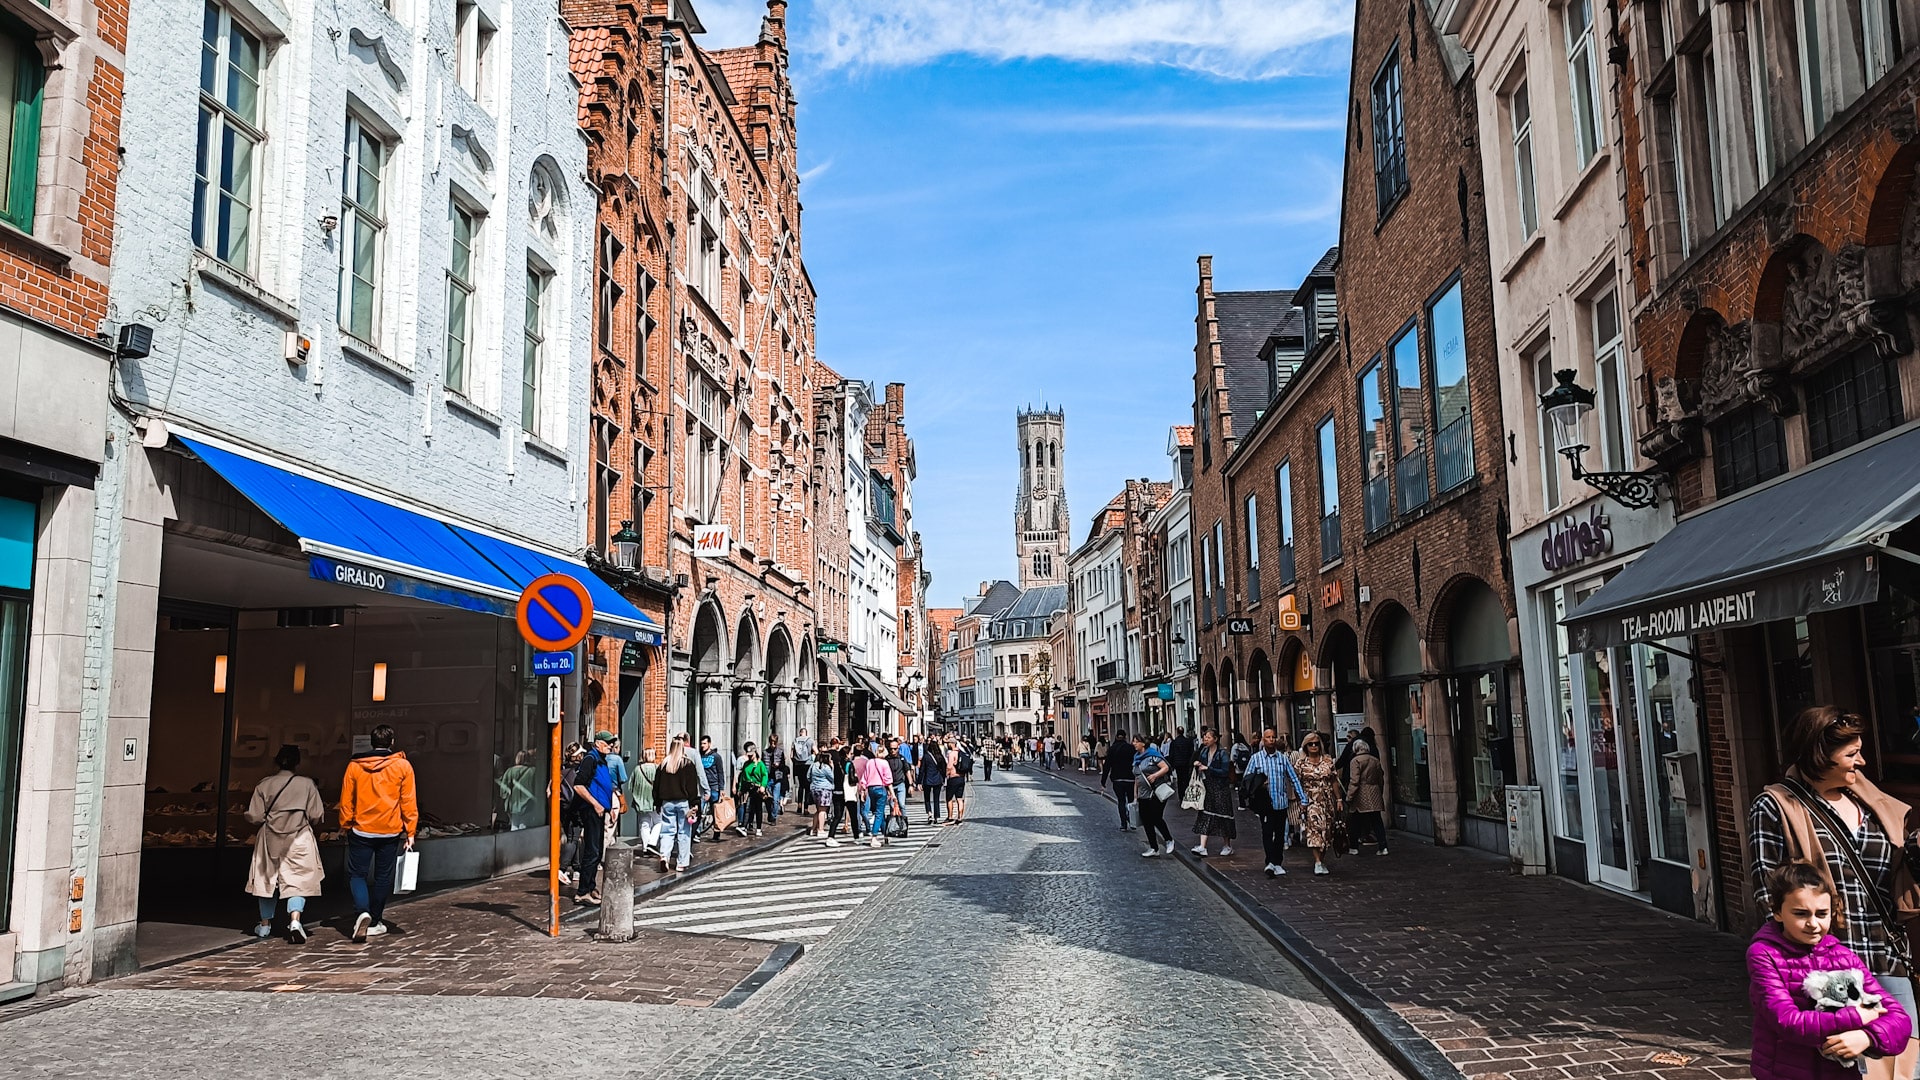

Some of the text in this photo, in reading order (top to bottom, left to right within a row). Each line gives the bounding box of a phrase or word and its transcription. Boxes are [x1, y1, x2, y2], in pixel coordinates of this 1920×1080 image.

[1443, 335, 1459, 358] HEMA
[1542, 504, 1608, 571] claire's
[335, 565, 385, 589] GIRALDO
[1321, 579, 1343, 609] HEMA
[1231, 620, 1250, 632] C&A
[1622, 606, 1685, 641] TEA-ROOM
[1690, 590, 1756, 630] LAURENT
[125, 743, 134, 756] 84
